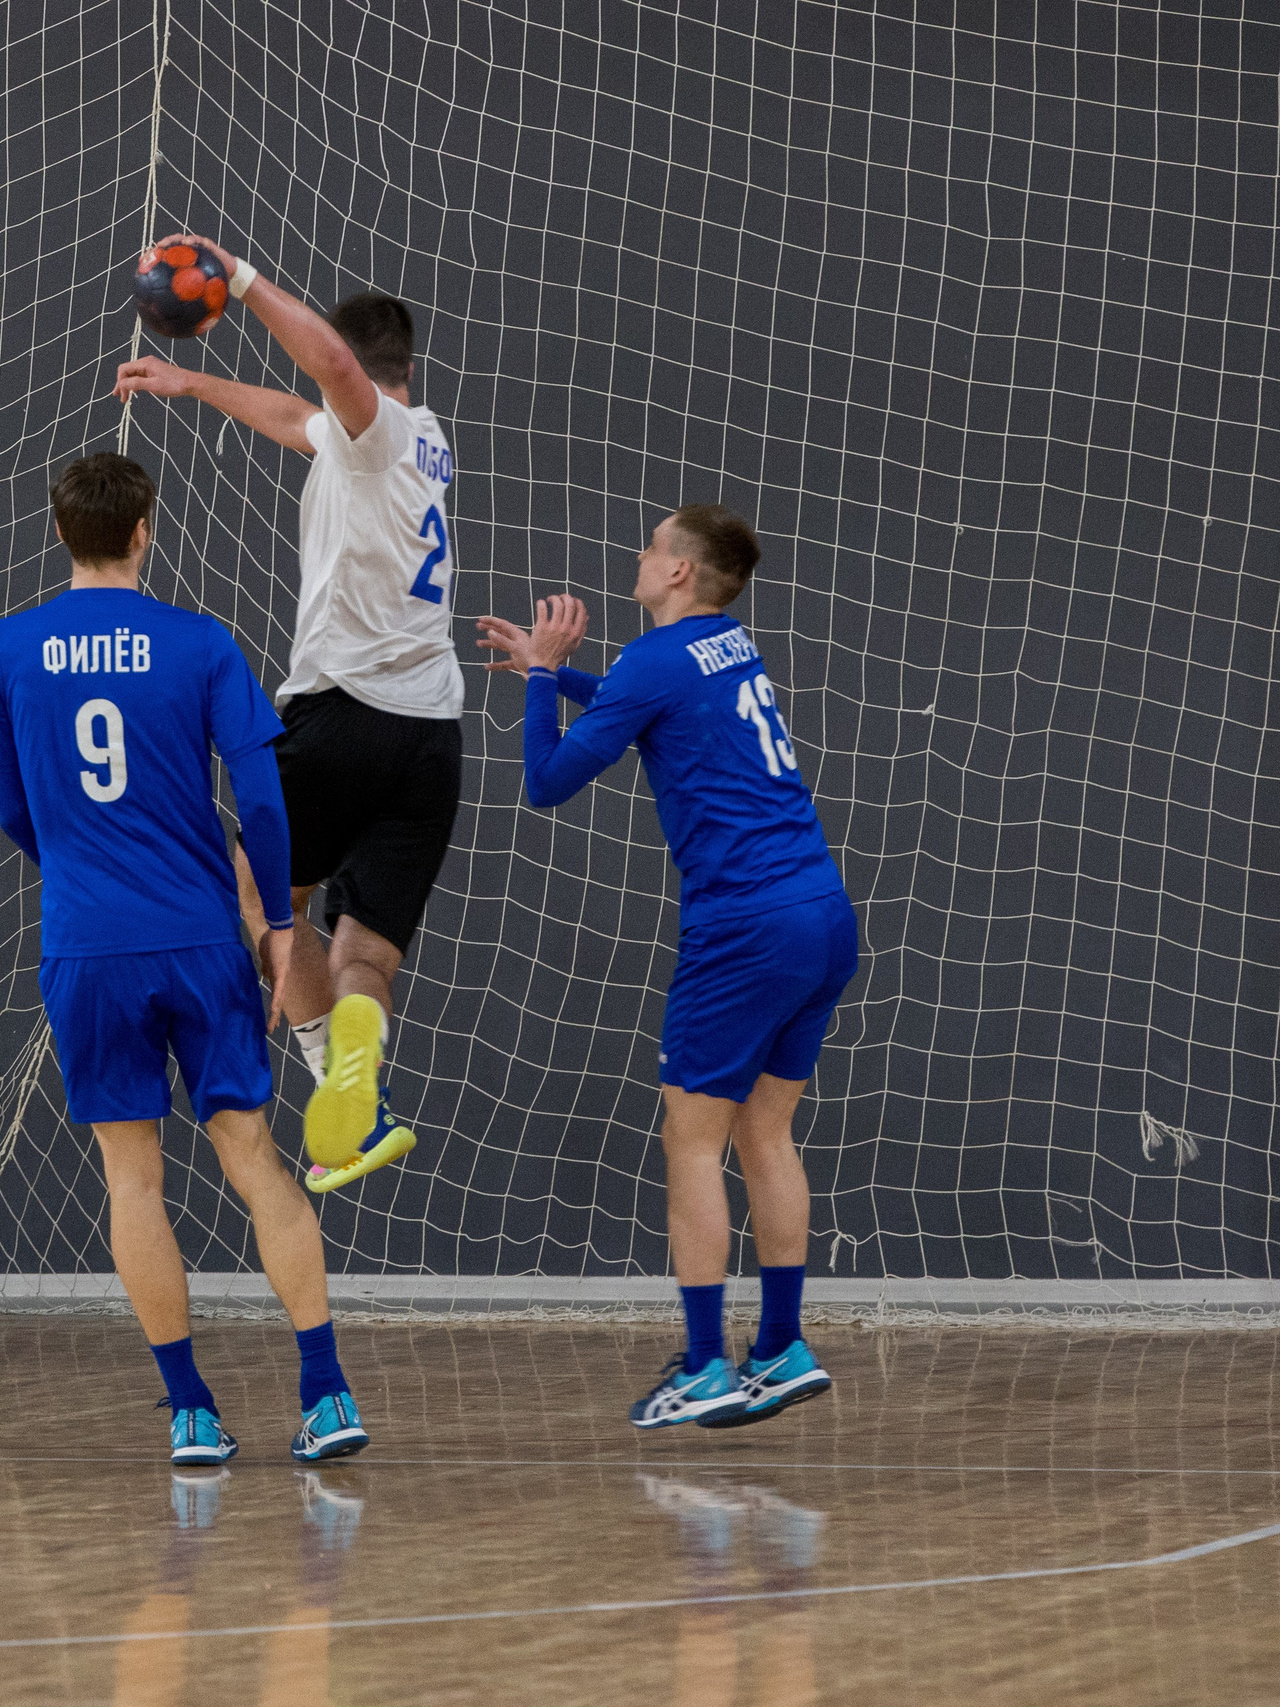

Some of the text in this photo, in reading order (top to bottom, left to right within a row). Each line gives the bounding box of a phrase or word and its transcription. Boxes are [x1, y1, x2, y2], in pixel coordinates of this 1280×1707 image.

[42, 628, 151, 674] ФИЛЁВ
[75, 698, 128, 803] 9
[736, 673, 798, 777] 13
